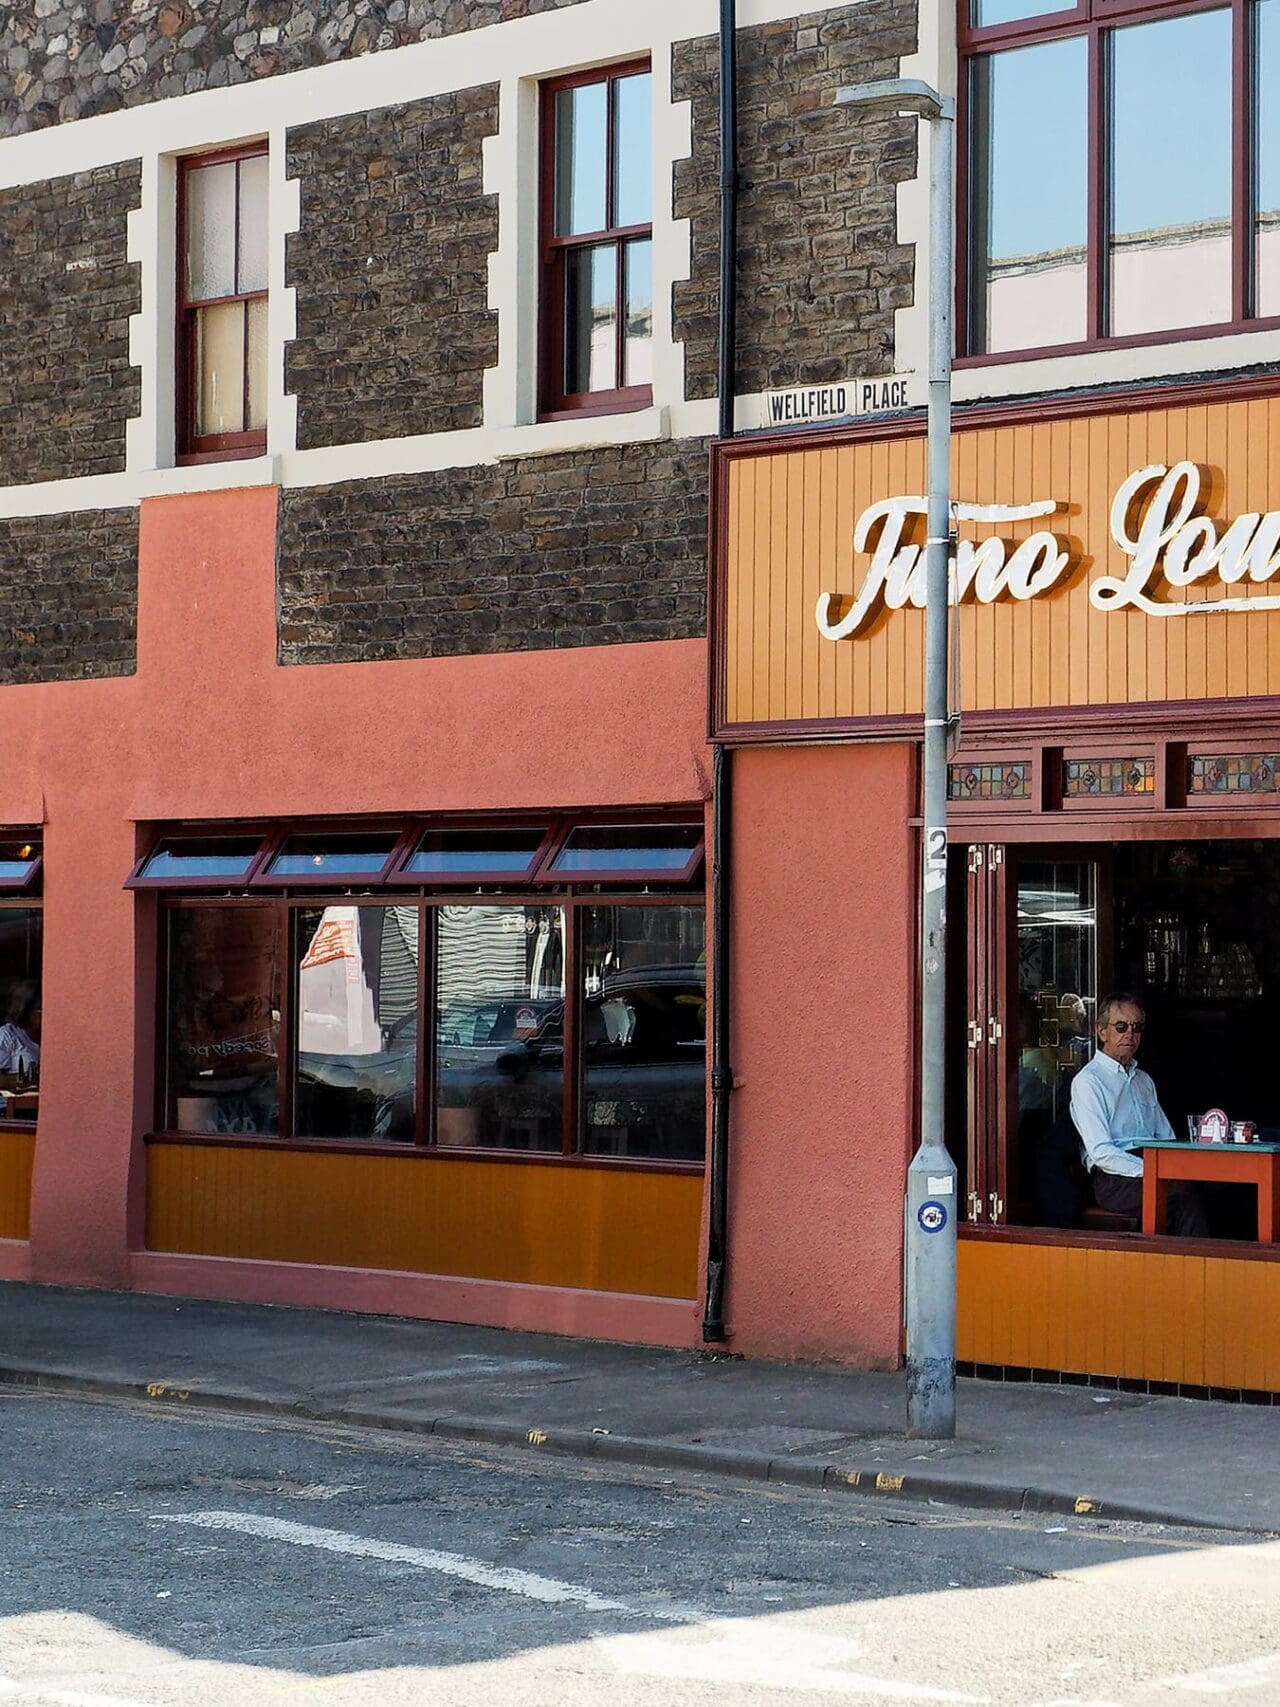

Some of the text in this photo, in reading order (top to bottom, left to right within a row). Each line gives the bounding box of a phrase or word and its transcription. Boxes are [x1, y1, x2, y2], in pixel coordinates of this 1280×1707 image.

[771, 380, 908, 421] WELLFIELD PLACE
[929, 830, 946, 860] 2
